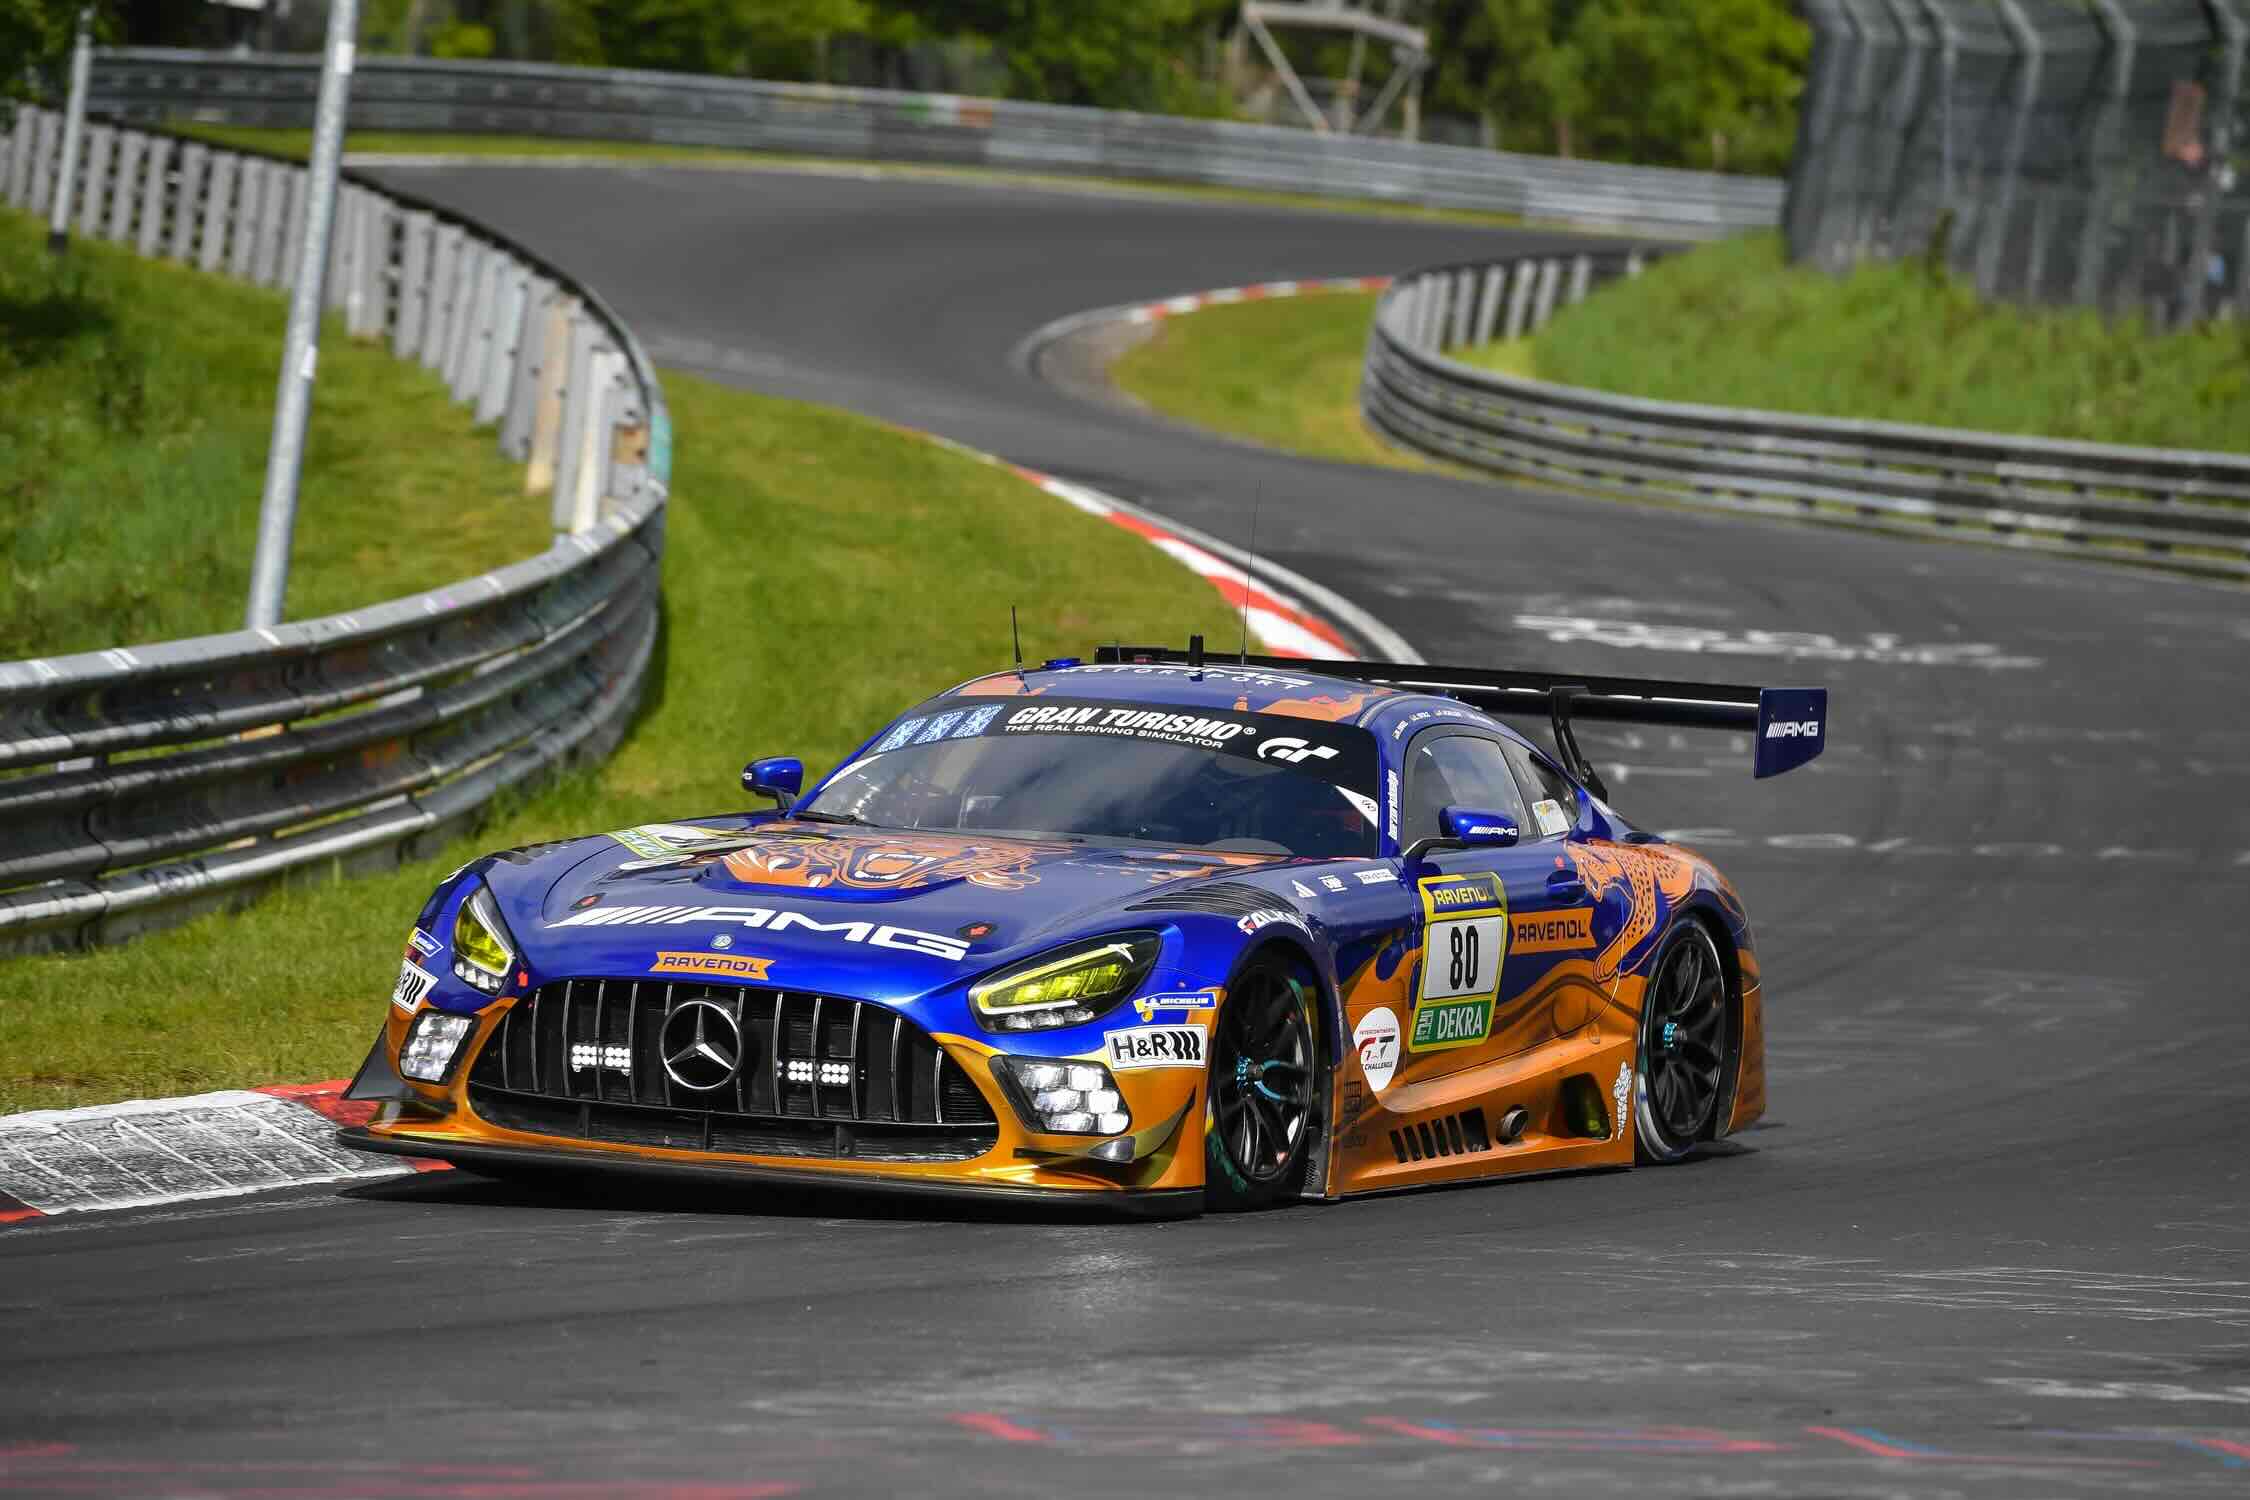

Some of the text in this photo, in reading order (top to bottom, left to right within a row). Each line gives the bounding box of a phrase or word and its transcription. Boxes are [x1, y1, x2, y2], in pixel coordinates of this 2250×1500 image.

[1008, 706, 1095, 725] GRAN
[1033, 725, 1072, 733] REAL
[1074, 725, 1135, 737] DRIVING
[1137, 729, 1224, 749] SIMULATOR
[1433, 886, 1493, 905] RAVENOL
[678, 906, 971, 961] AMG
[1518, 919, 1587, 944] RAVENOL
[663, 956, 760, 974] RAVENOL
[1450, 925, 1479, 990] 80
[1437, 1005, 1483, 1040] DEKRA
[1113, 1032, 1170, 1060] H&R
